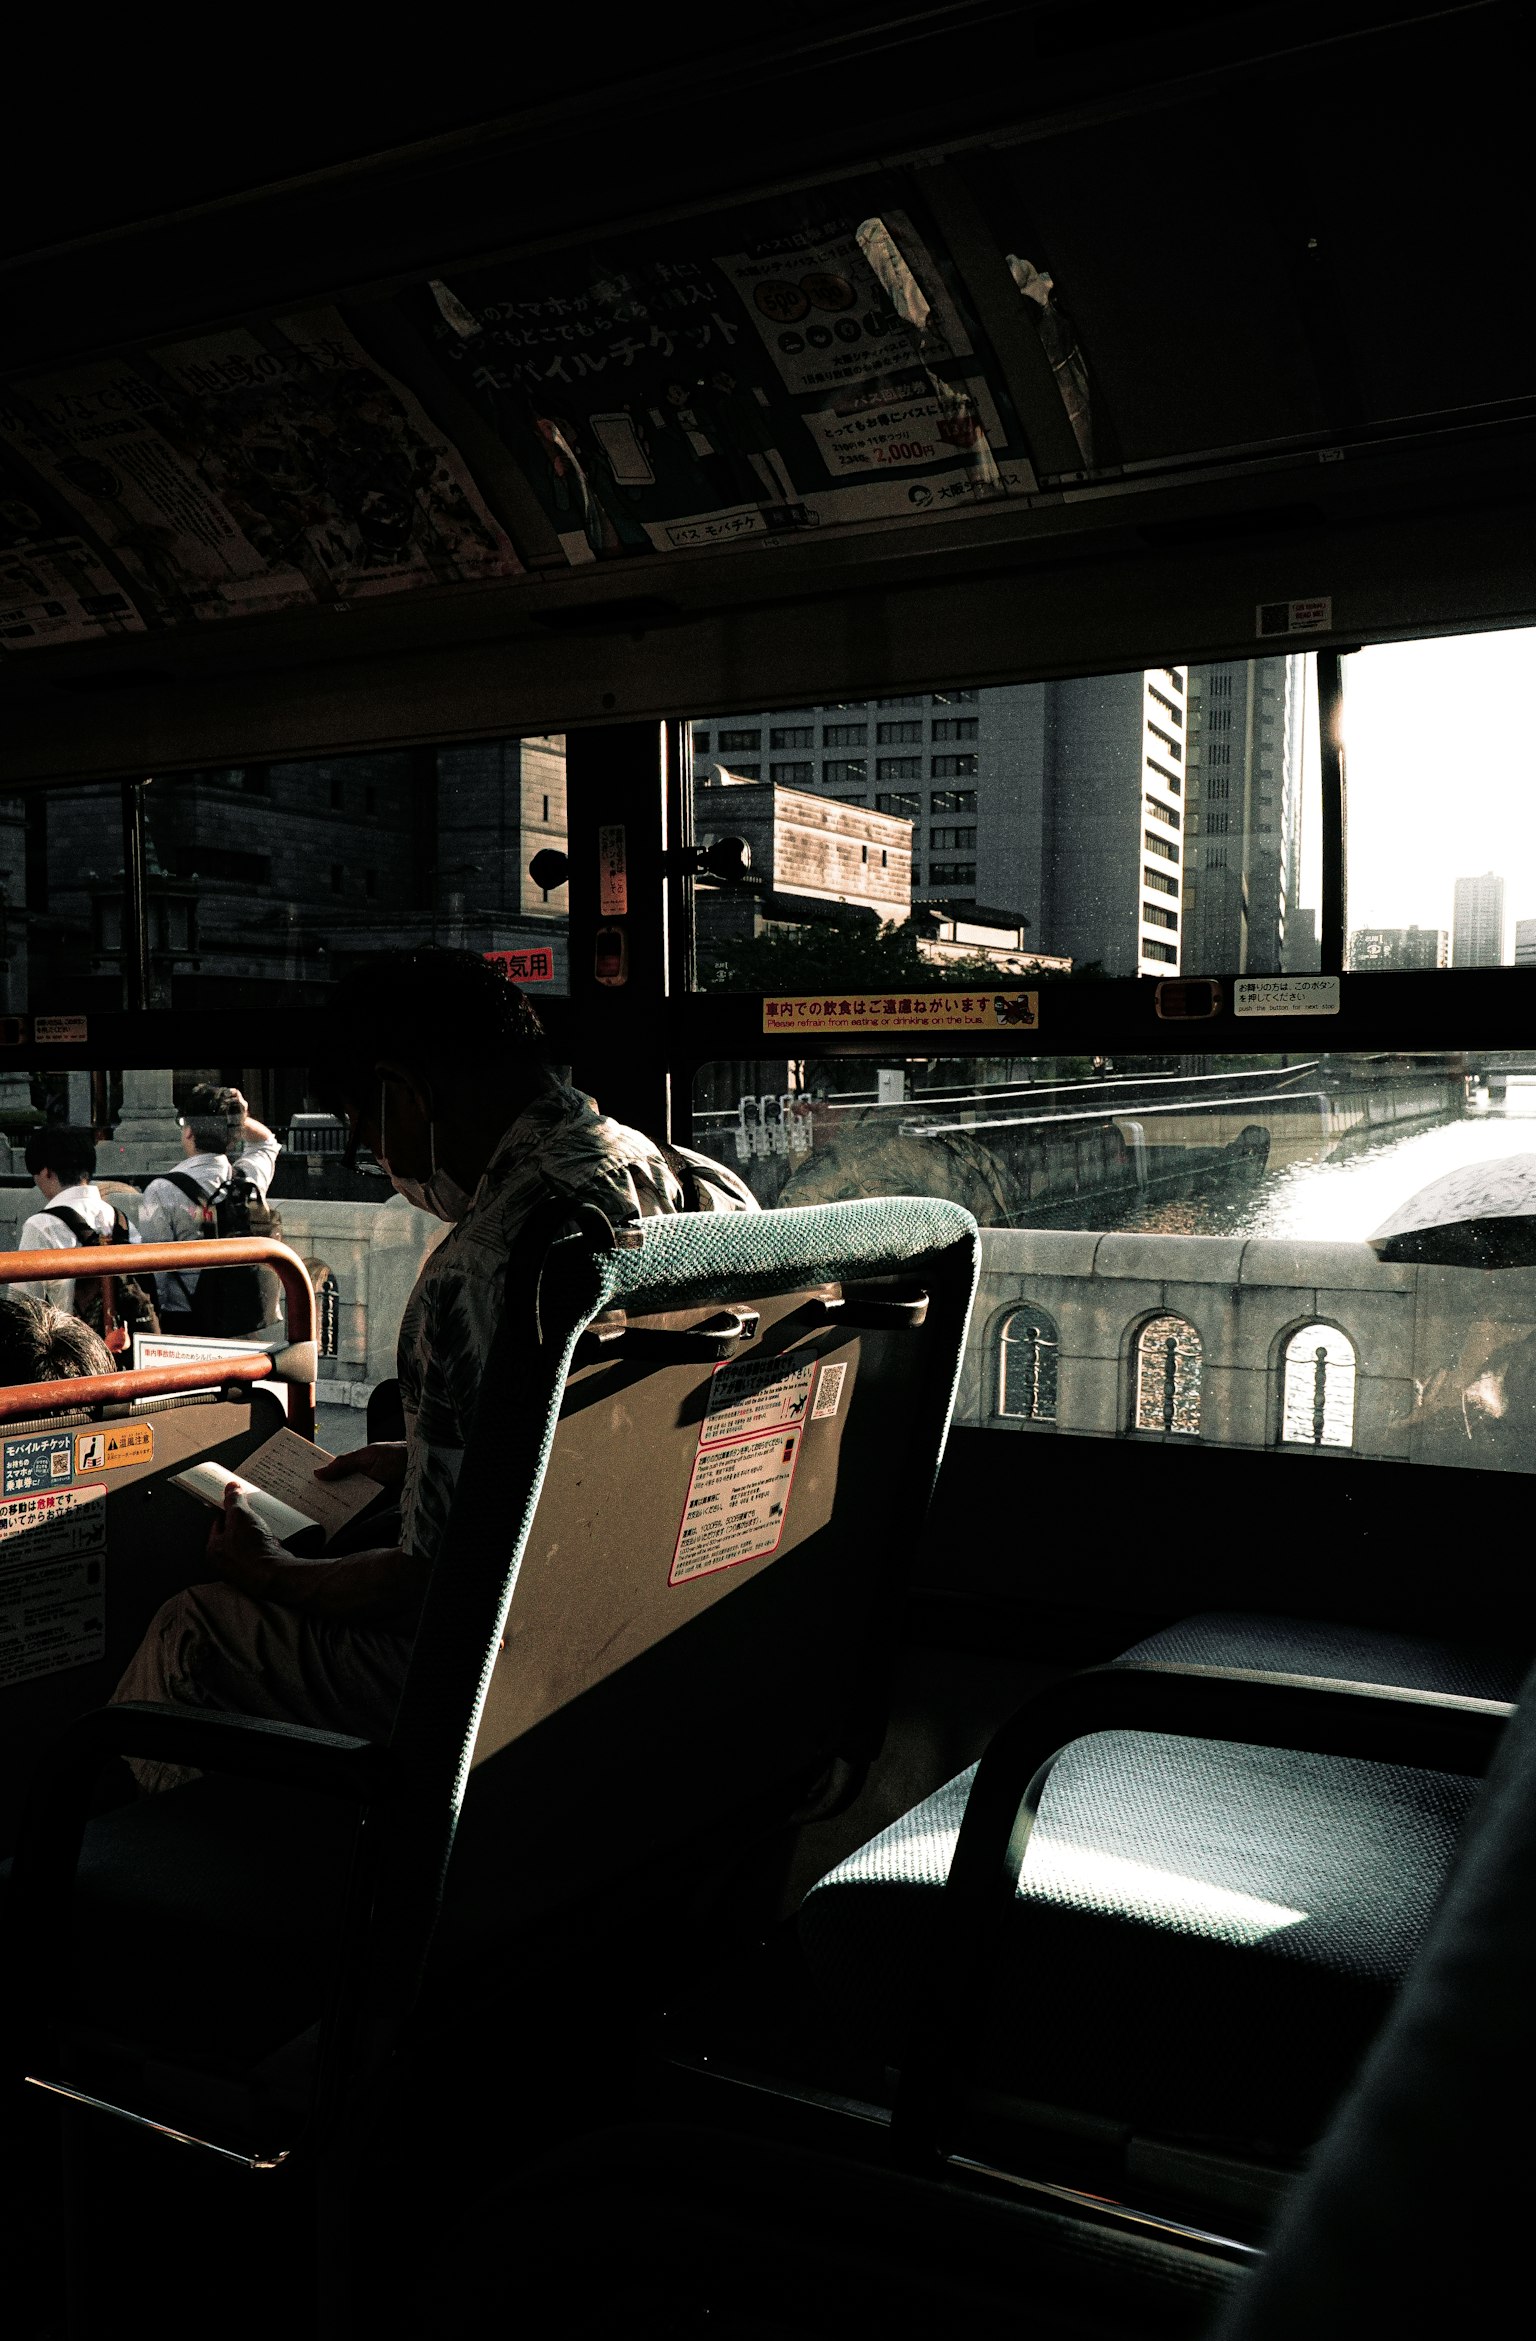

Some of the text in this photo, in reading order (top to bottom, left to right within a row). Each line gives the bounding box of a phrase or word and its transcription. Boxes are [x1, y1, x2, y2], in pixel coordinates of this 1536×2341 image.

[764, 291, 798, 311] 500
[811, 285, 843, 300] 100
[873, 441, 935, 464] 2,000円
[676, 529, 701, 541] バス
[705, 516, 755, 536] モバチケ
[766, 997, 990, 1017] 車内での飲食はご遠慮ねがいます
[1239, 993, 1306, 1002] を押してください
[767, 1019, 795, 1028] Please
[797, 1018, 825, 1028] refrain
[829, 1019, 849, 1027] from
[851, 1018, 878, 1028] eating
[893, 1017, 929, 1027] drinking
[947, 1016, 962, 1025] the
[6, 1437, 71, 1457] モバイルチケット
[6, 1459, 30, 1469] お持ちの
[6, 1468, 33, 1479] スマホが
[0, 1493, 77, 1518] の移動は危険です。
